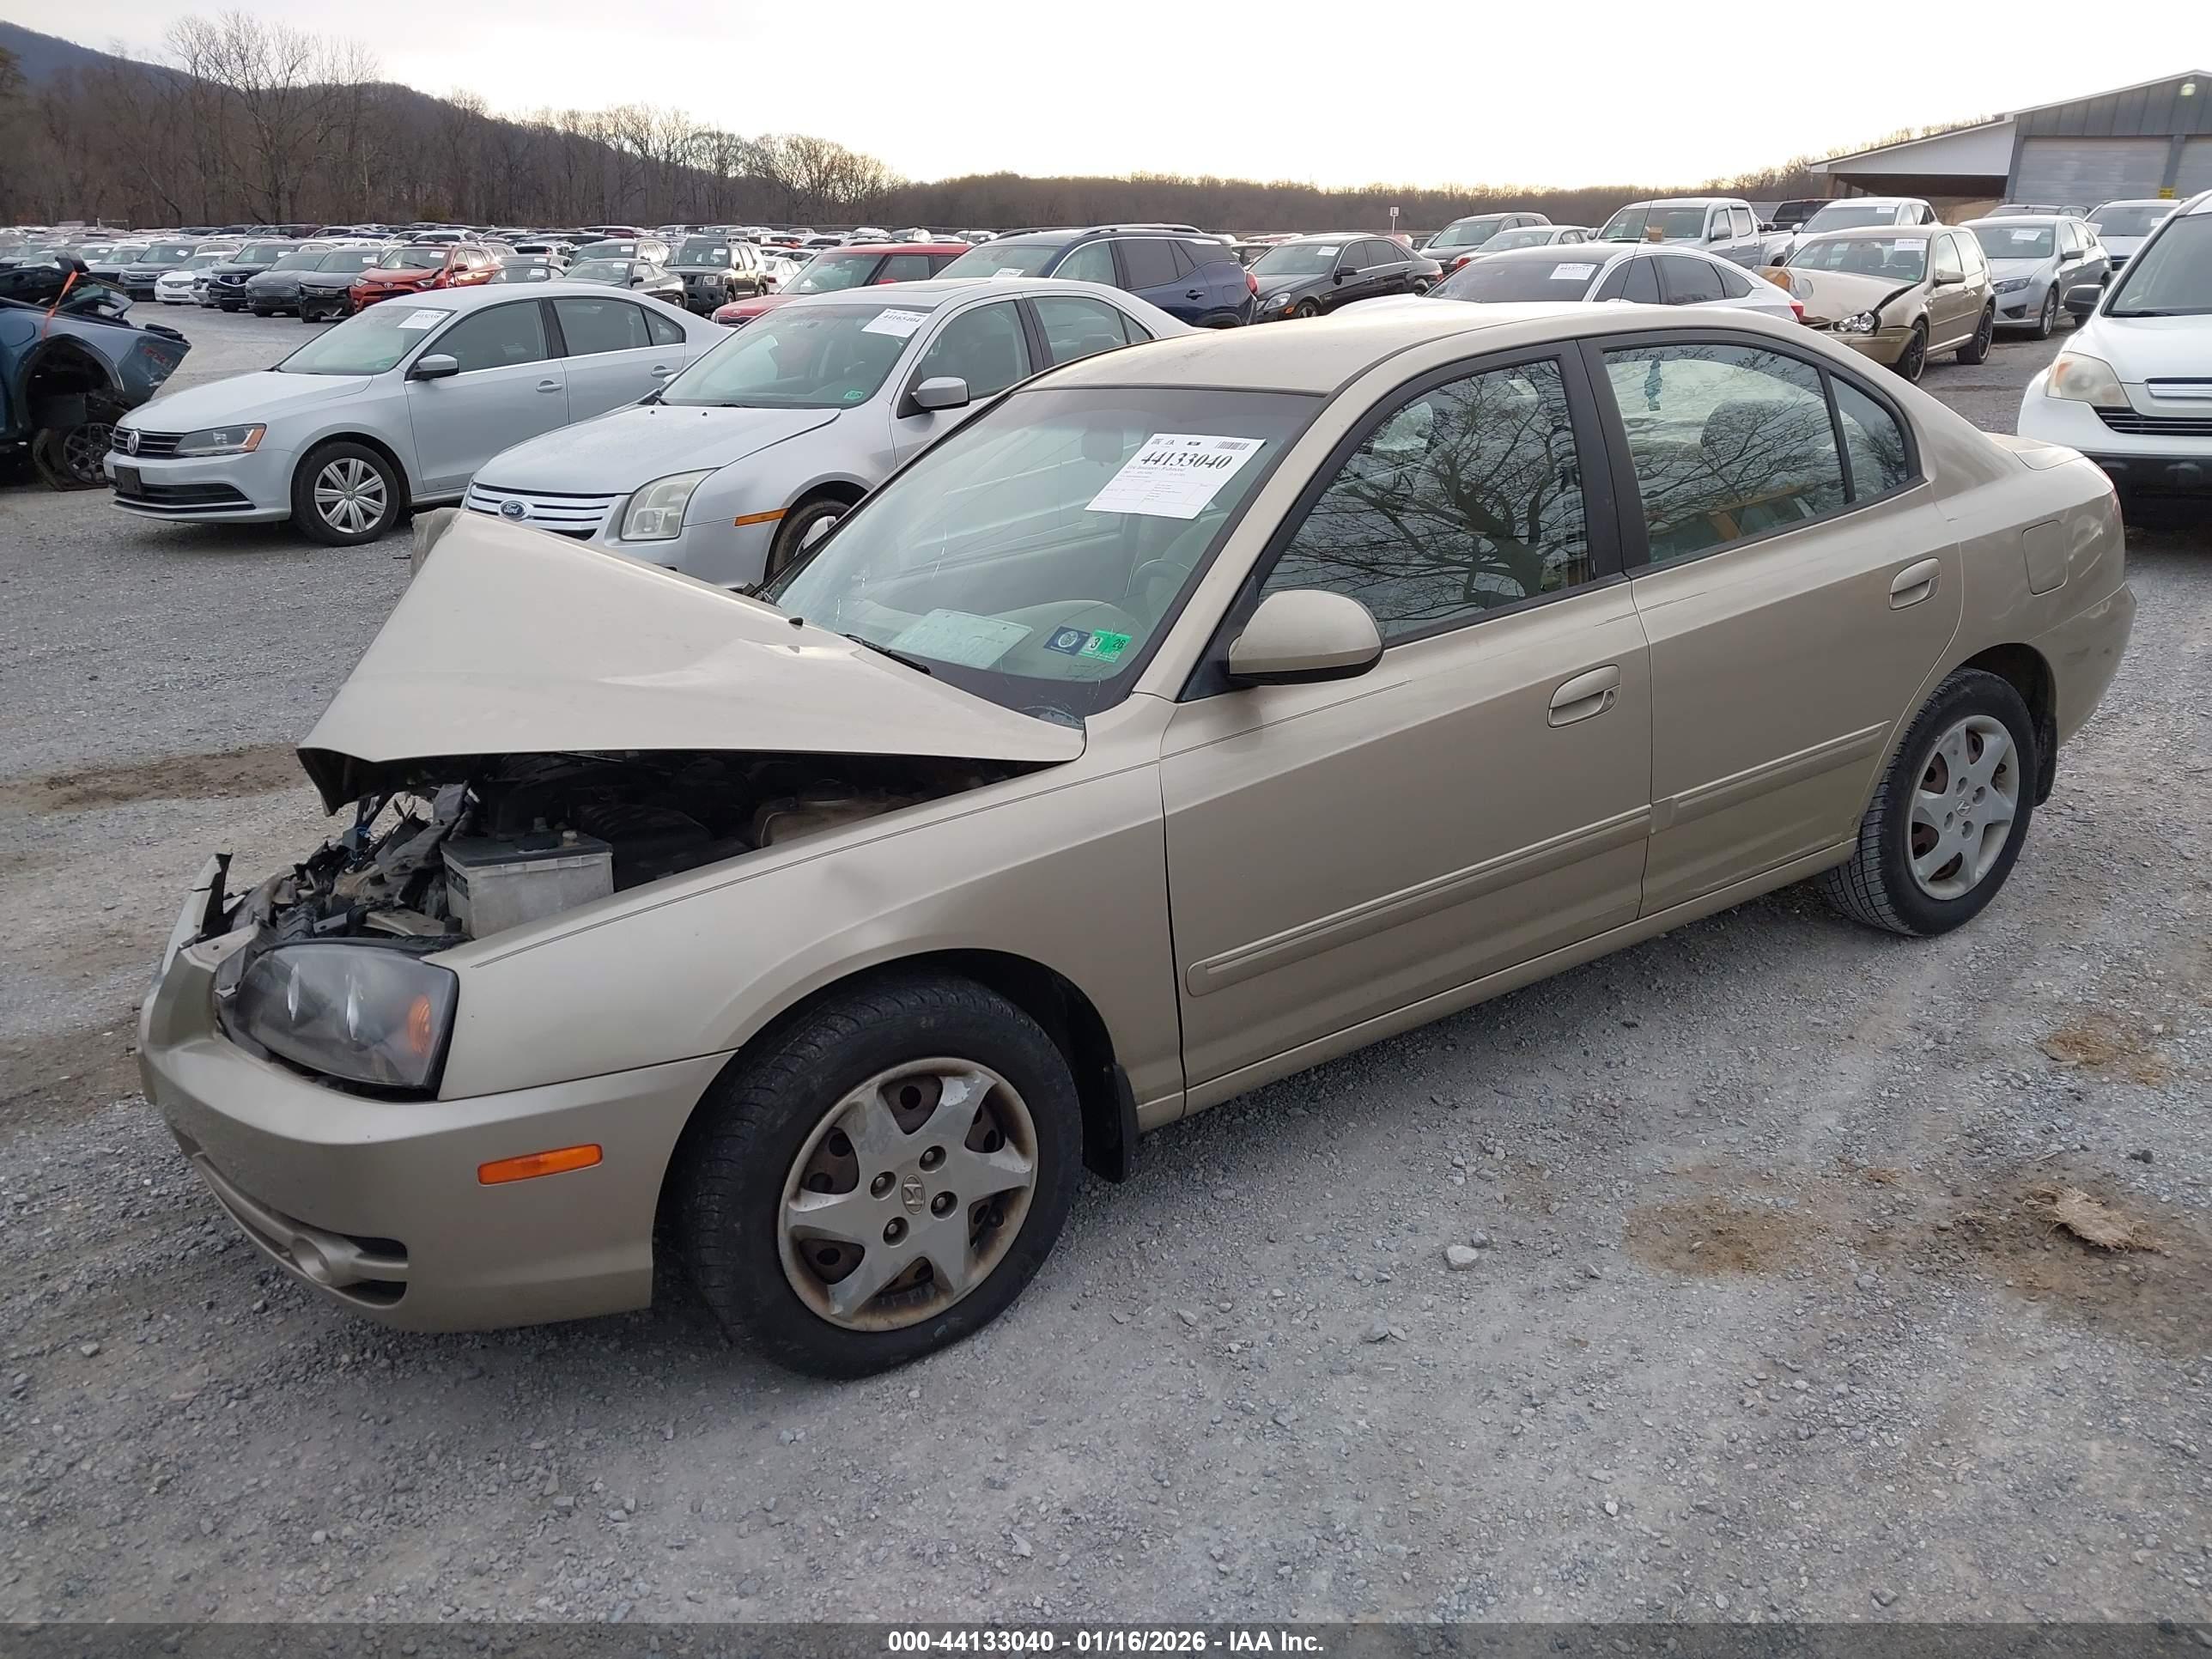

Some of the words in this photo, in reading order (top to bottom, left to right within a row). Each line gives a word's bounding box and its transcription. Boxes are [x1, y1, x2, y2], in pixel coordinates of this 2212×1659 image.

[1140, 451, 1233, 470] 44133040
[503, 503, 520, 514] Ford
[1091, 637, 1101, 649] 3
[1112, 638, 1127, 649] 26
